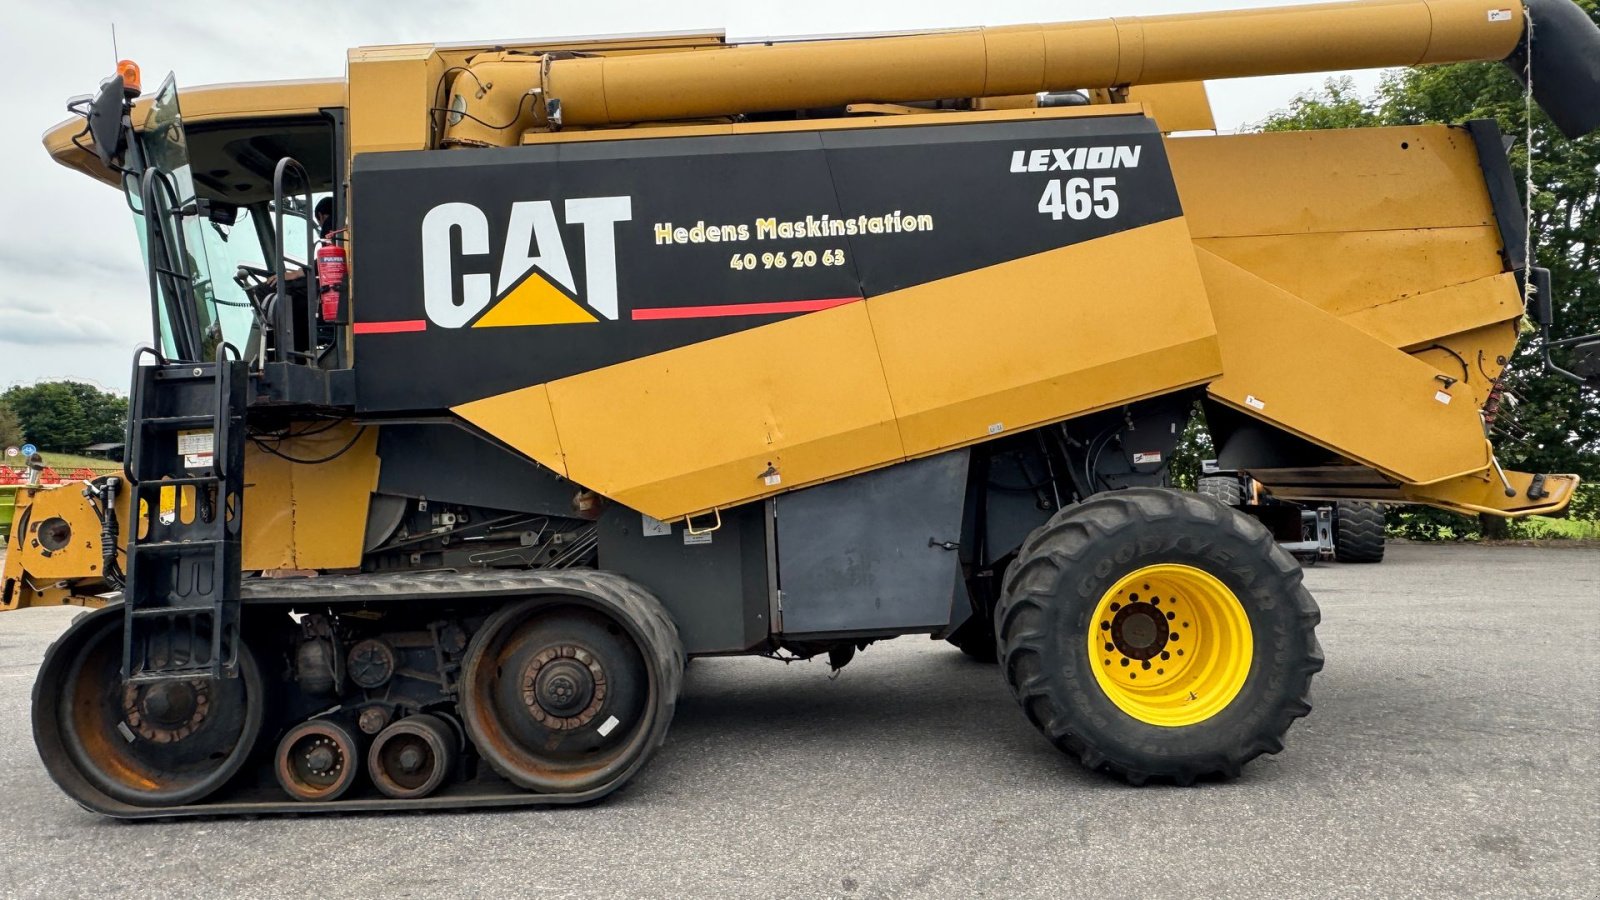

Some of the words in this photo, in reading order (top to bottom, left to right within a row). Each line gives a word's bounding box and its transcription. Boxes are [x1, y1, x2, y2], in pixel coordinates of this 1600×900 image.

[1009, 145, 1141, 173] LEXION
[1038, 177, 1119, 220] 465
[654, 220, 750, 245] Hedens
[755, 210, 934, 240] Maskinstation
[421, 195, 633, 329] CAT
[730, 253, 757, 271] 40
[761, 251, 787, 269] 96
[791, 250, 817, 268] 20
[822, 248, 846, 266] 63
[1076, 534, 1279, 611] GOODYEAR
